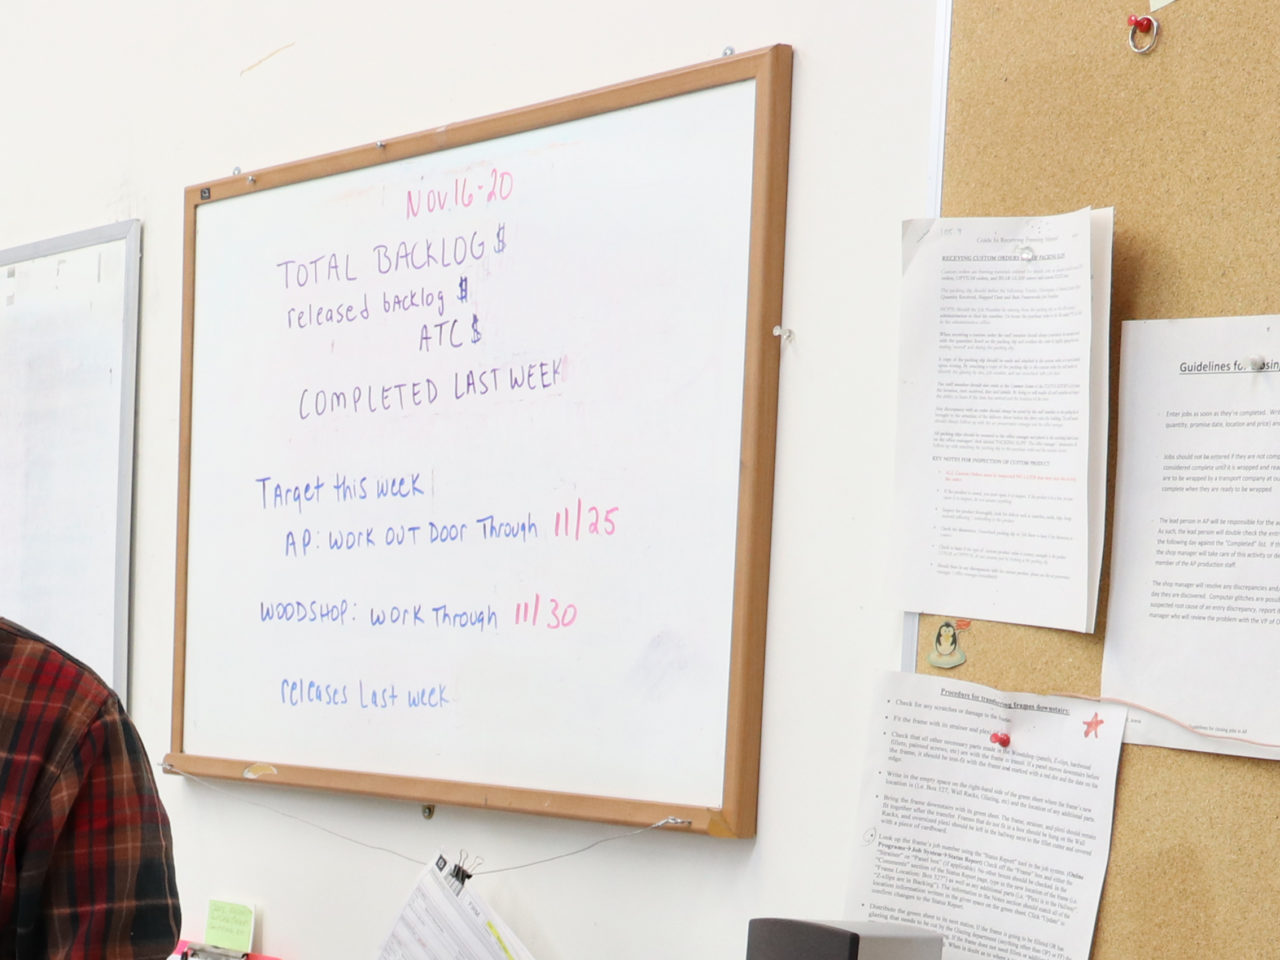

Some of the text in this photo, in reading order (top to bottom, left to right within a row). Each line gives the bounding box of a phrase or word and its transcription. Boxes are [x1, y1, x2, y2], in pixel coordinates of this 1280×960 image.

[277, 253, 358, 289] TOTAL
[373, 231, 486, 274] BACKLOG
[287, 293, 370, 329] released
[419, 319, 463, 352] ATC
[1179, 361, 1231, 374] Guidelines
[299, 357, 562, 420] COMPLETED LAST WEEK
[333, 472, 368, 502] this
[376, 472, 425, 498] week
[284, 528, 321, 557] AP:
[384, 525, 421, 546] OUT
[476, 512, 538, 542] Through
[554, 497, 619, 541] 11/25
[260, 599, 358, 625] WOODSHOP:
[432, 604, 498, 632] Through
[514, 593, 578, 629] 11/30
[280, 678, 449, 708] releases Last week
